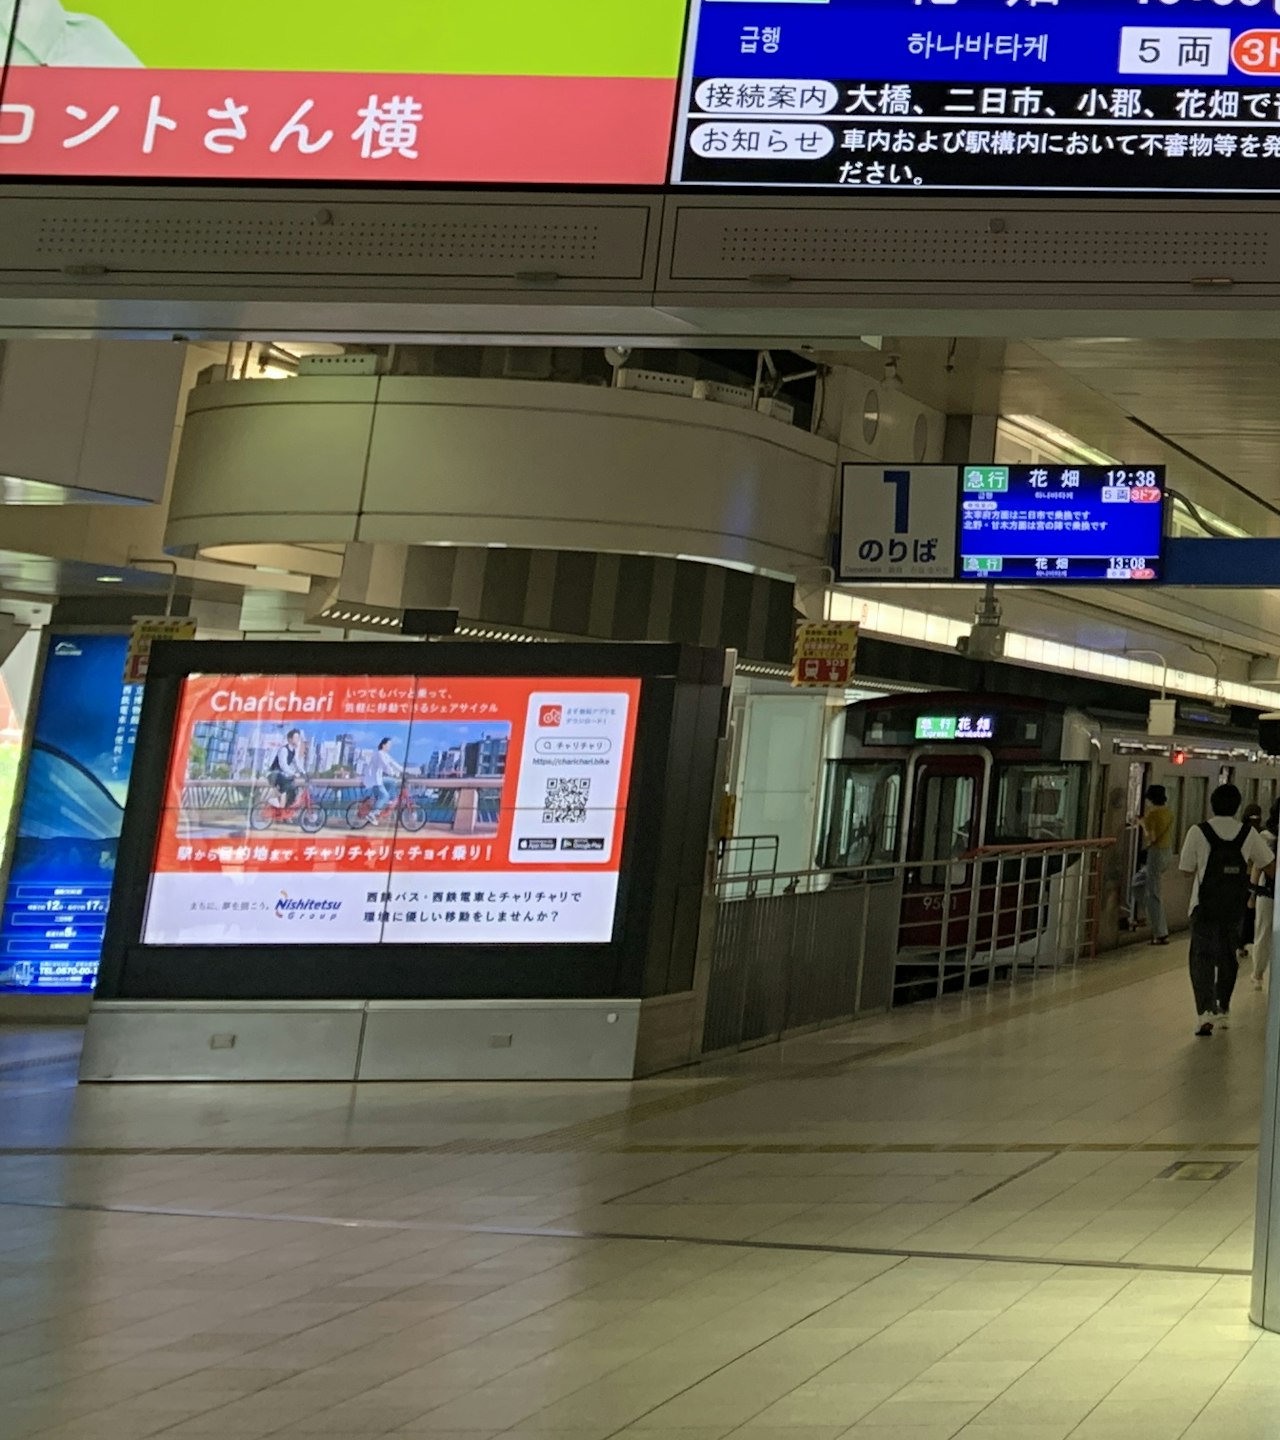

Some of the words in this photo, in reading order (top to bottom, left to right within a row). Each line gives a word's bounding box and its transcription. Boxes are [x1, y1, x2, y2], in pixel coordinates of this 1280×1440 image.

[1138, 36, 1213, 69] 5両
[704, 82, 828, 110] 接続案内
[700, 126, 824, 155] お知らせ
[838, 159, 926, 187] ださい。
[966, 470, 1006, 488] 急行
[1028, 469, 1081, 489] 花畑
[1106, 470, 1157, 488] 12:38
[882, 470, 911, 534] 1
[1130, 488, 1162, 502] 3ドア
[858, 537, 939, 564] のりば
[1034, 557, 1070, 571] 花畑
[1108, 557, 1147, 571] 13:08
[210, 689, 334, 713] Charichari
[274, 896, 343, 914] Nishitetsu
